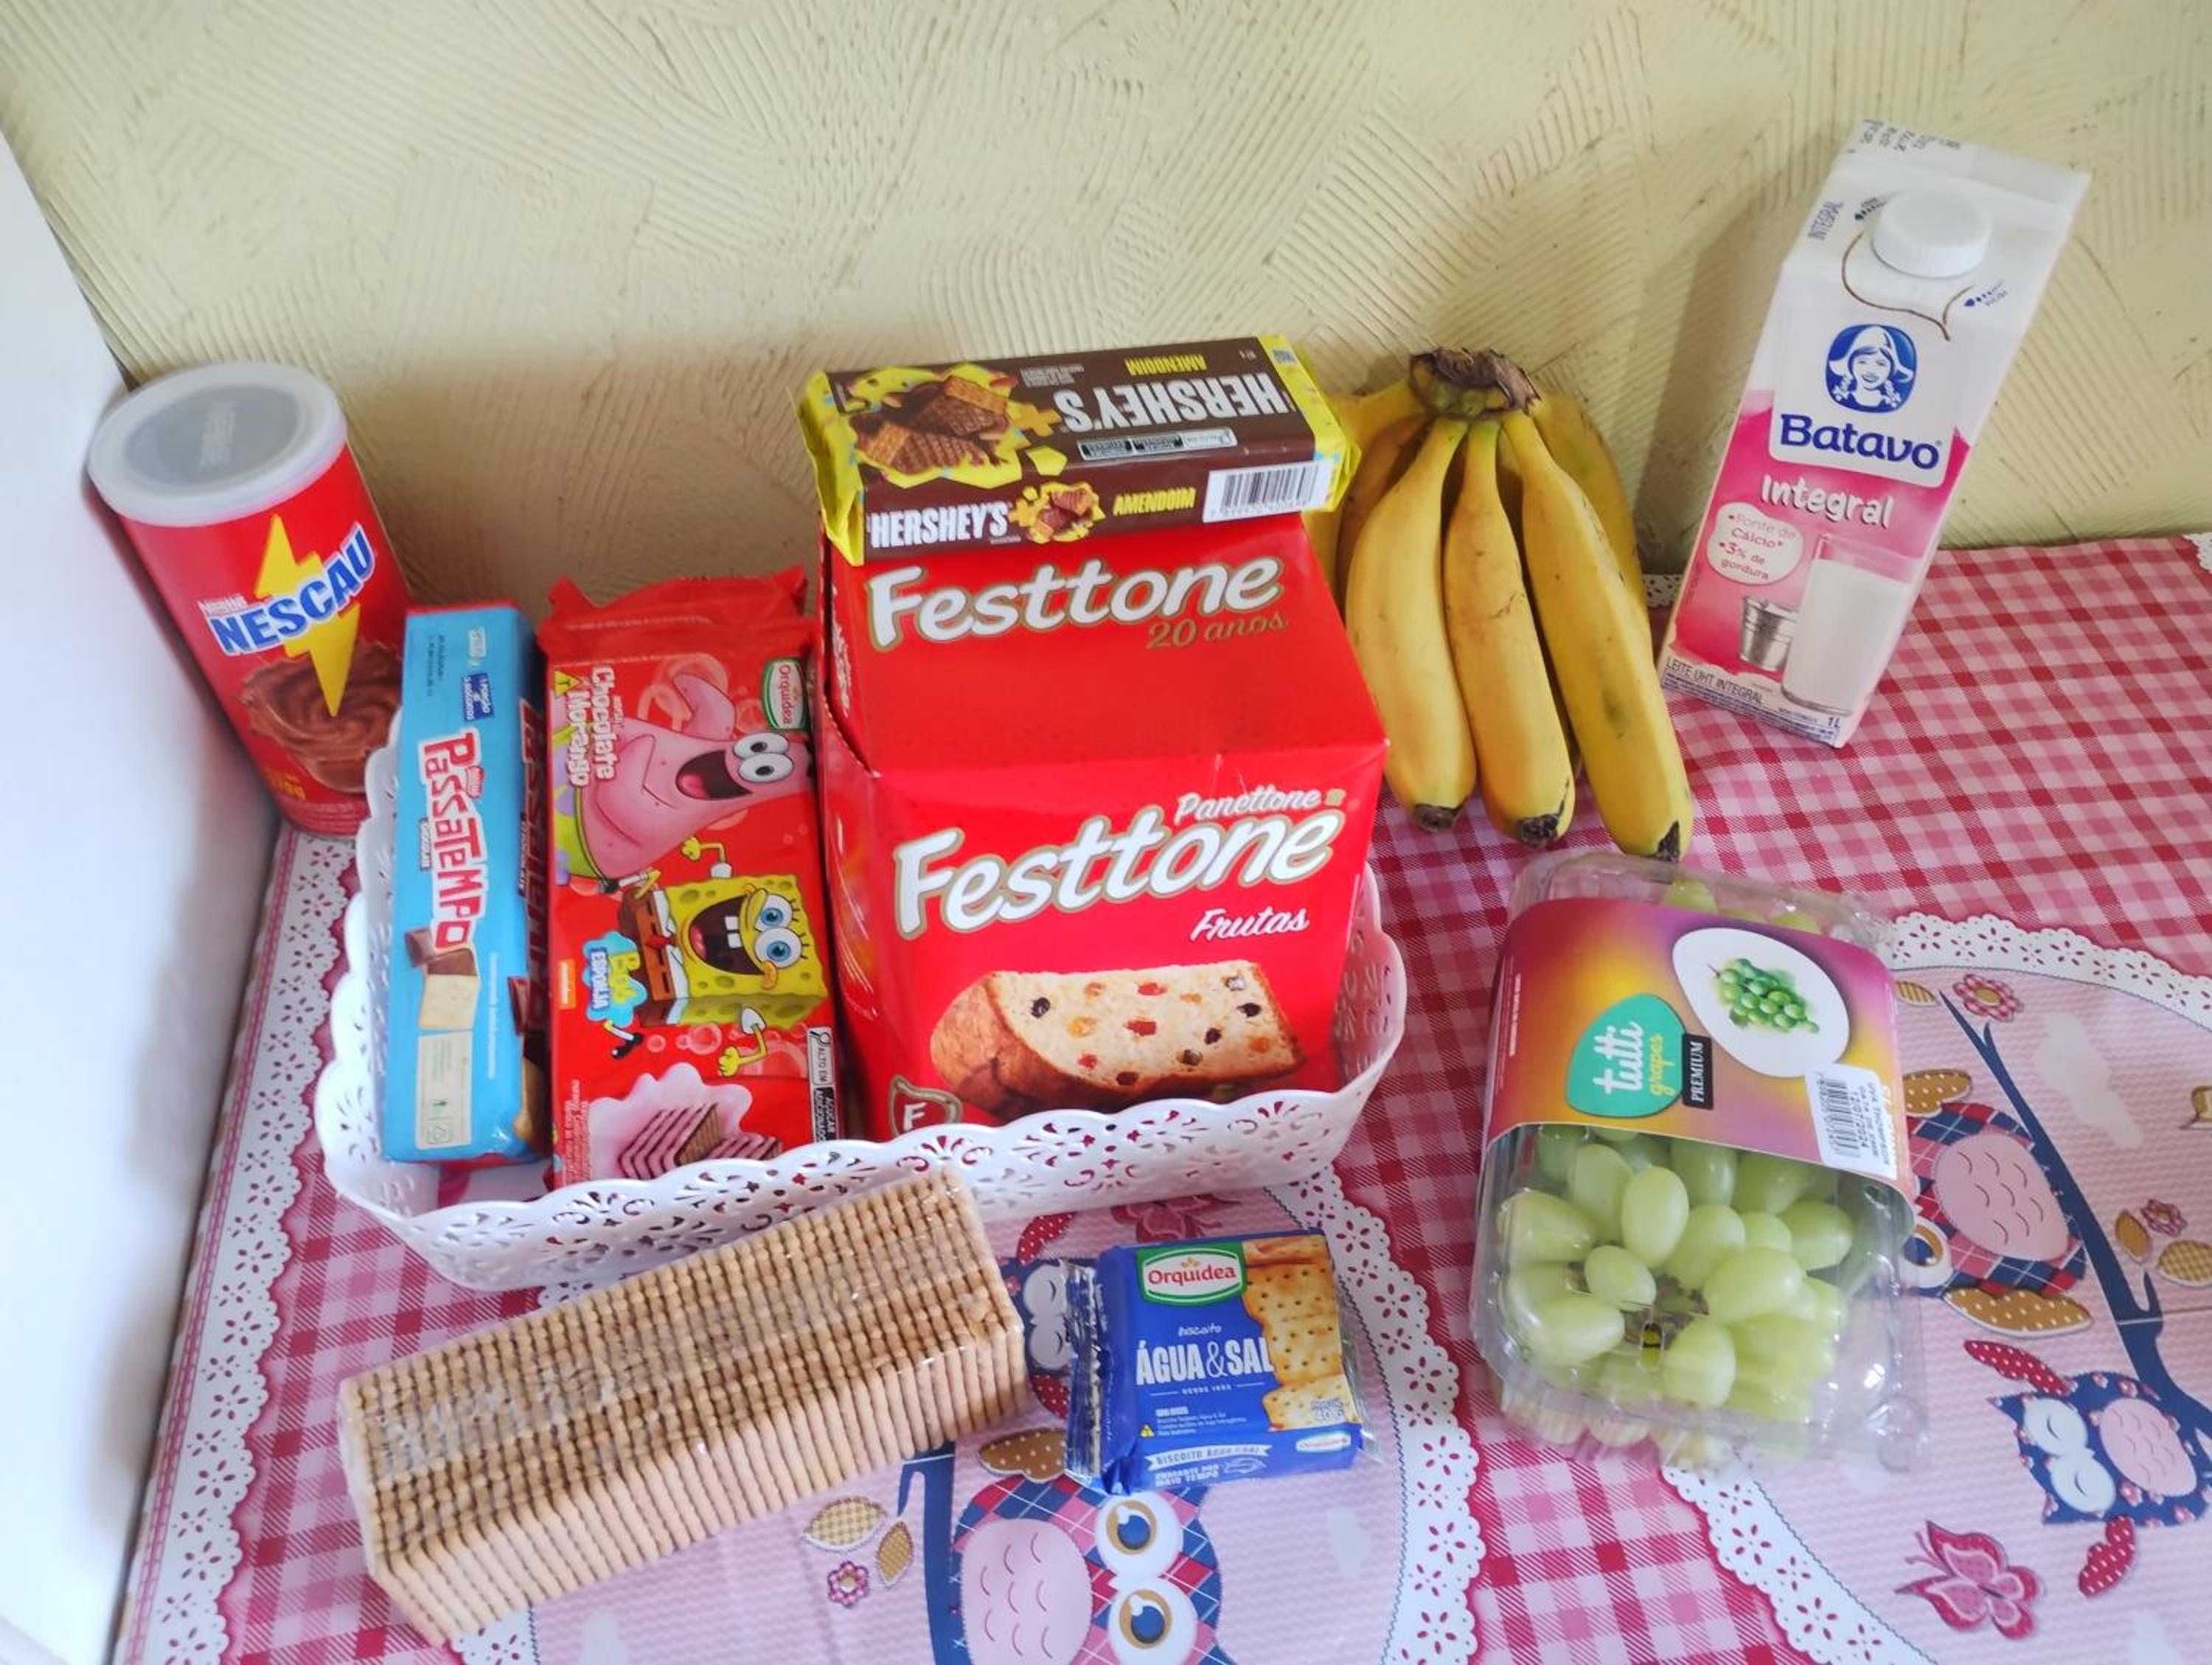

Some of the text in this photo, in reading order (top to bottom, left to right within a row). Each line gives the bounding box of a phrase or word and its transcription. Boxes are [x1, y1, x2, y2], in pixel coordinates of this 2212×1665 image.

[1125, 352, 1207, 375] AMENDOIM
[1053, 372, 1294, 434] HERSHEY'S
[1779, 413, 1941, 470] Batavo
[869, 502, 1010, 549] HERSHEY'S
[1113, 487, 1197, 516] AMENDOIM
[1760, 474, 1894, 529] Integral
[209, 523, 375, 655] NESCAU
[866, 555, 1284, 650] Festtone
[1145, 614, 1287, 650] 20 anos
[1666, 657, 1691, 678] LEITE
[1694, 670, 1715, 686] UHT
[1715, 678, 1764, 705] INTEGRAL
[567, 690, 591, 786] Morango
[591, 666, 619, 779] Chocolate
[1174, 787, 1321, 824] Panettone
[893, 804, 1346, 940] Festtone
[1189, 907, 1310, 942] Frutas
[818, 1048, 827, 1068] ALTO
[1648, 1034, 1663, 1096] grapes
[1688, 1040, 1706, 1103] PREMIUM
